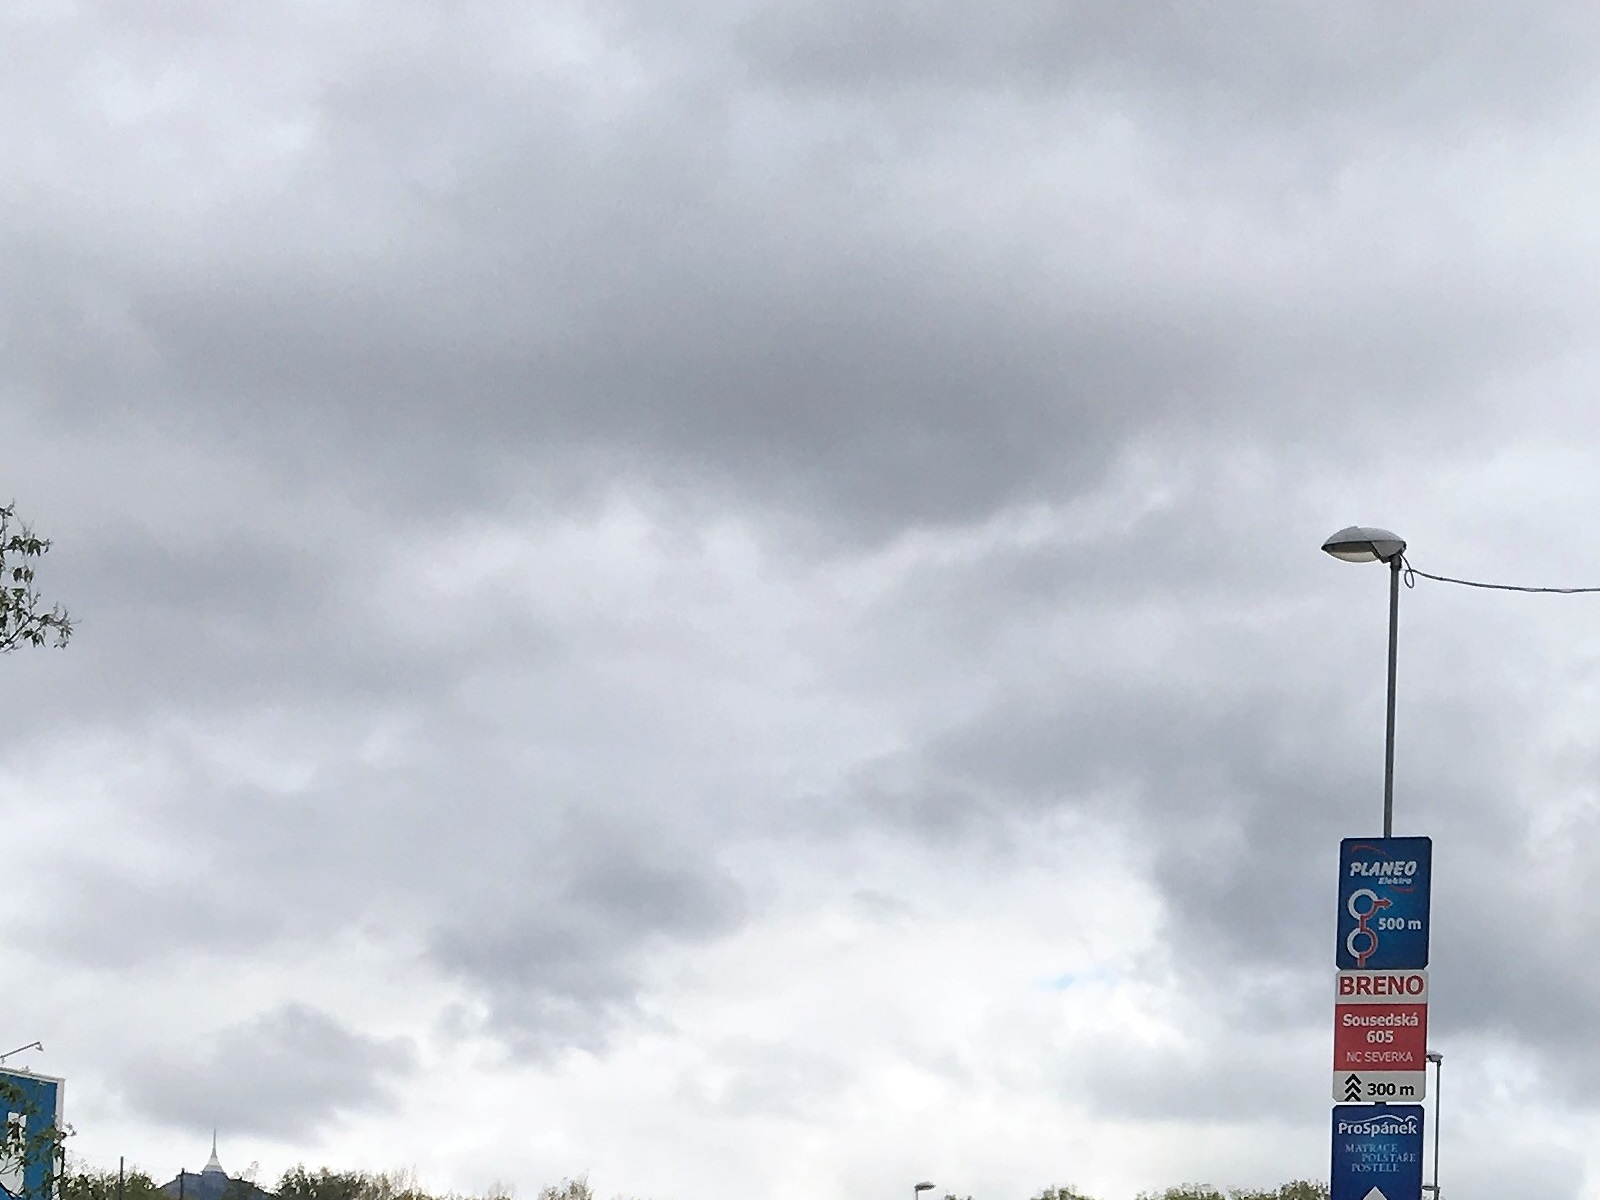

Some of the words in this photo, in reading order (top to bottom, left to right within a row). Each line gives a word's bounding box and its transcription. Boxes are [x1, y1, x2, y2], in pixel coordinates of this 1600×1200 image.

[1350, 861, 1417, 876] PLANEO
[1378, 917, 1405, 931] 500
[1408, 919, 1421, 930] m
[1339, 975, 1424, 996] BRENO
[1343, 1012, 1419, 1027] Sousedská
[1366, 1030, 1394, 1044] 605
[1346, 1051, 1362, 1063] NC
[1364, 1051, 1413, 1063] SEVERKA
[1367, 1083, 1396, 1096] 300
[1399, 1085, 1415, 1096] m
[1338, 1121, 1417, 1138] ProSpánek
[1345, 1143, 1398, 1153] MATRACE
[1351, 1163, 1400, 1172] POSTELE
